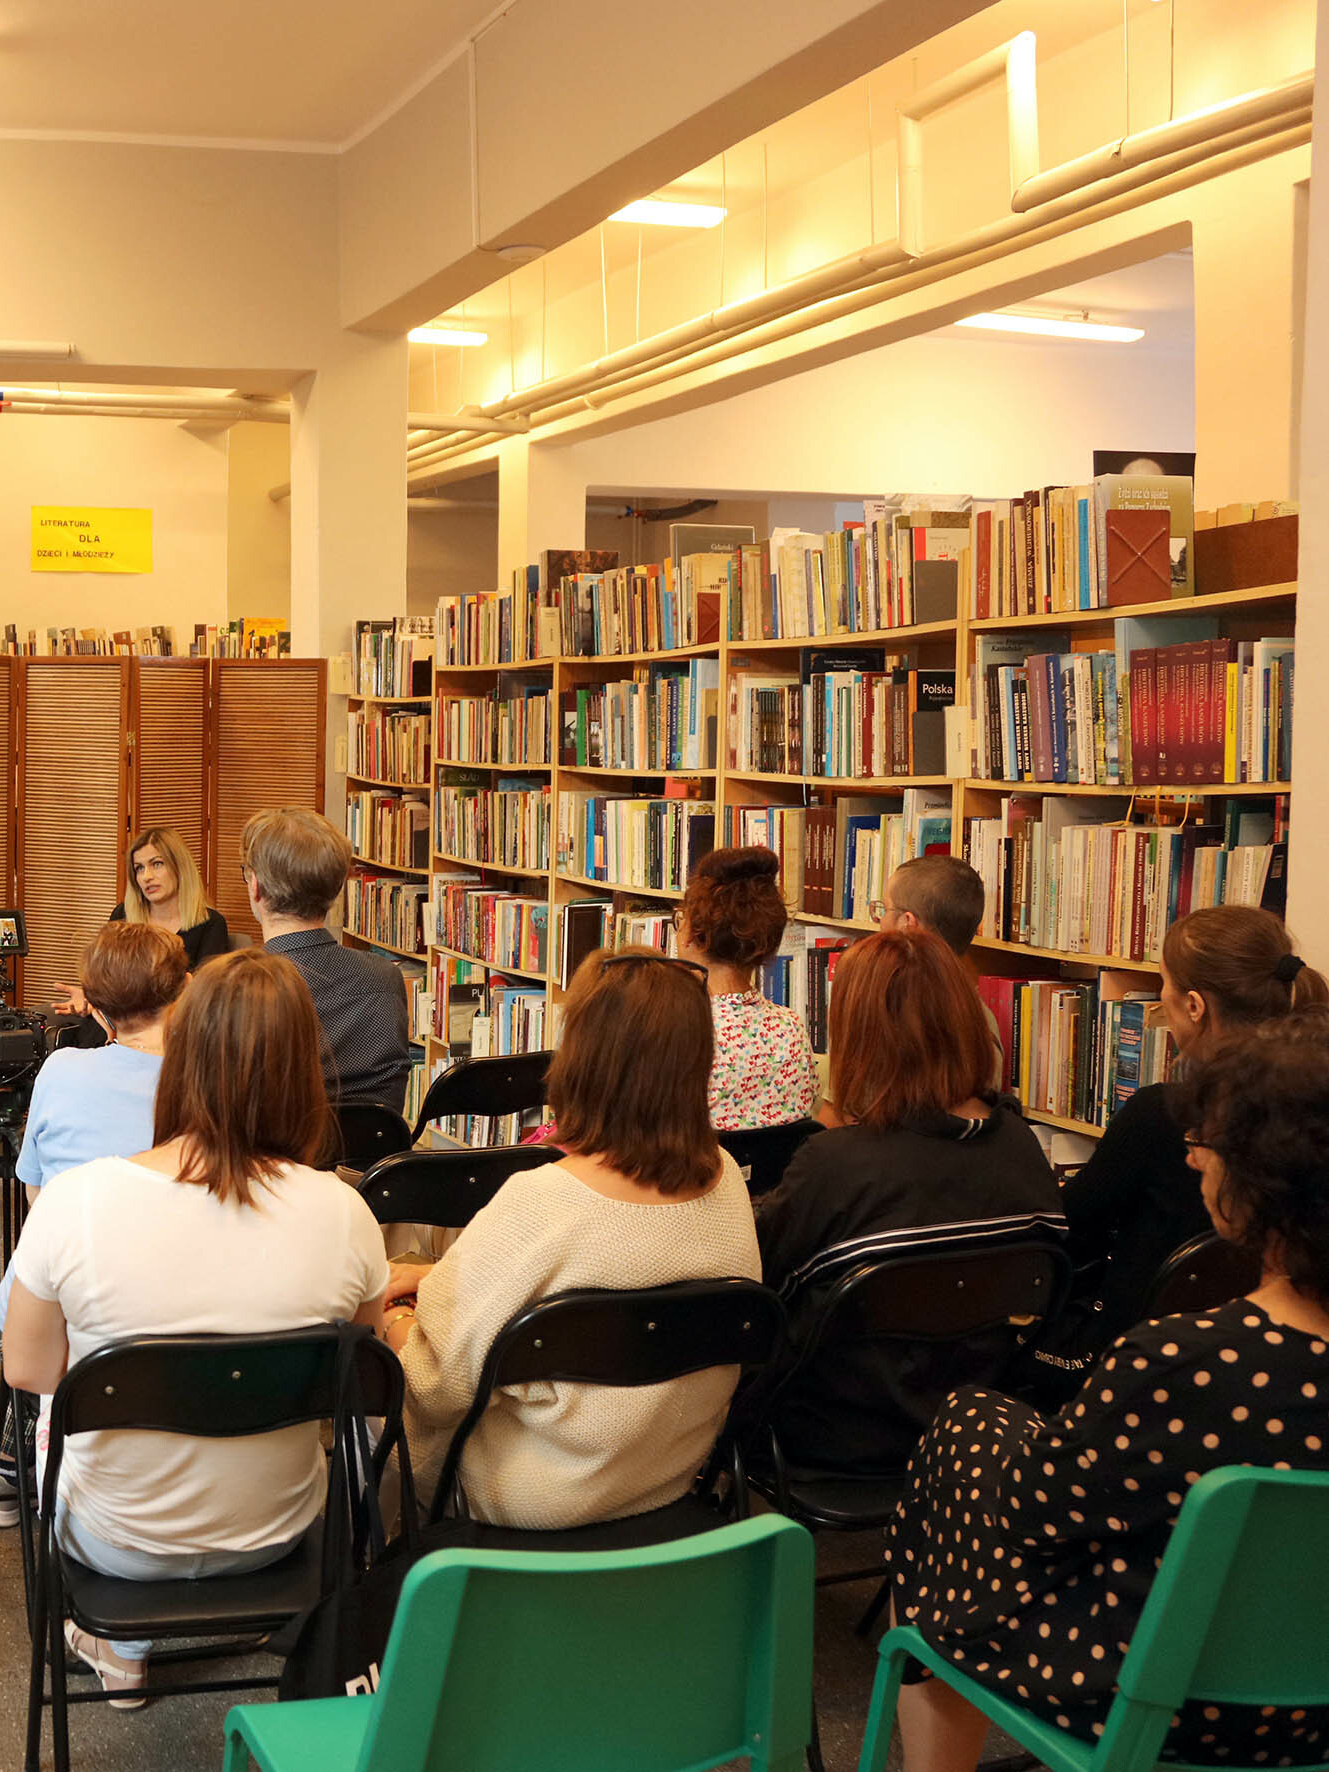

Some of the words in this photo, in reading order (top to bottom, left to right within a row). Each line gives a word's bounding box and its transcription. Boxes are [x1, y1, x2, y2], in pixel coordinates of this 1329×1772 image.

[40, 519, 90, 528] LITERATURA
[78, 534, 101, 543] DLA
[72, 550, 114, 558] MŁODZIEŻY
[922, 683, 953, 695] Polska
